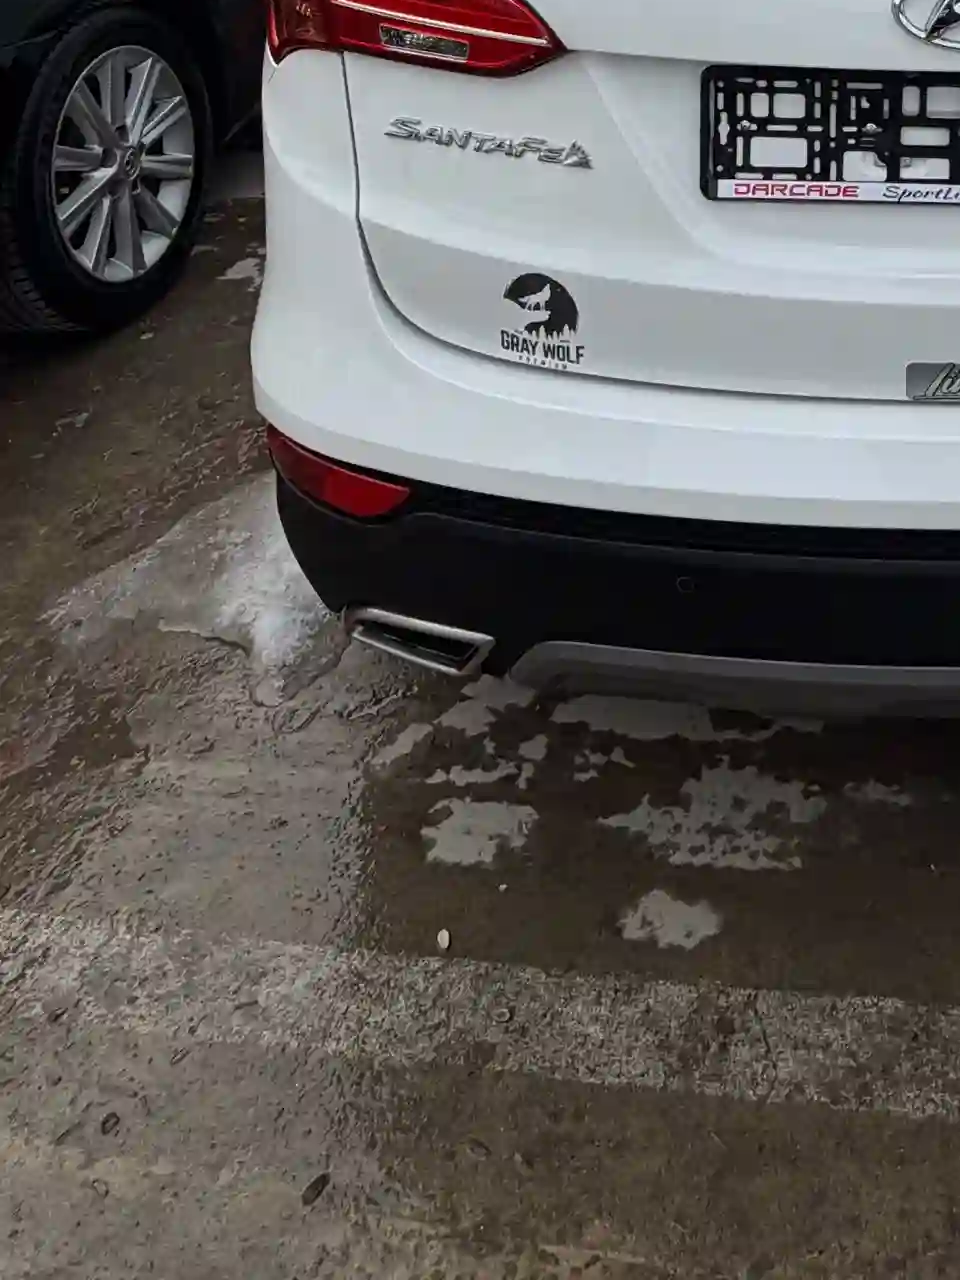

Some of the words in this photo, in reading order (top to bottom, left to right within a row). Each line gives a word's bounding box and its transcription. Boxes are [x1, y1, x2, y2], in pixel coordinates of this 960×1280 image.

[733, 183, 860, 198] DARCADE
[500, 329, 539, 356] GRAY
[542, 340, 585, 365] WOLF
